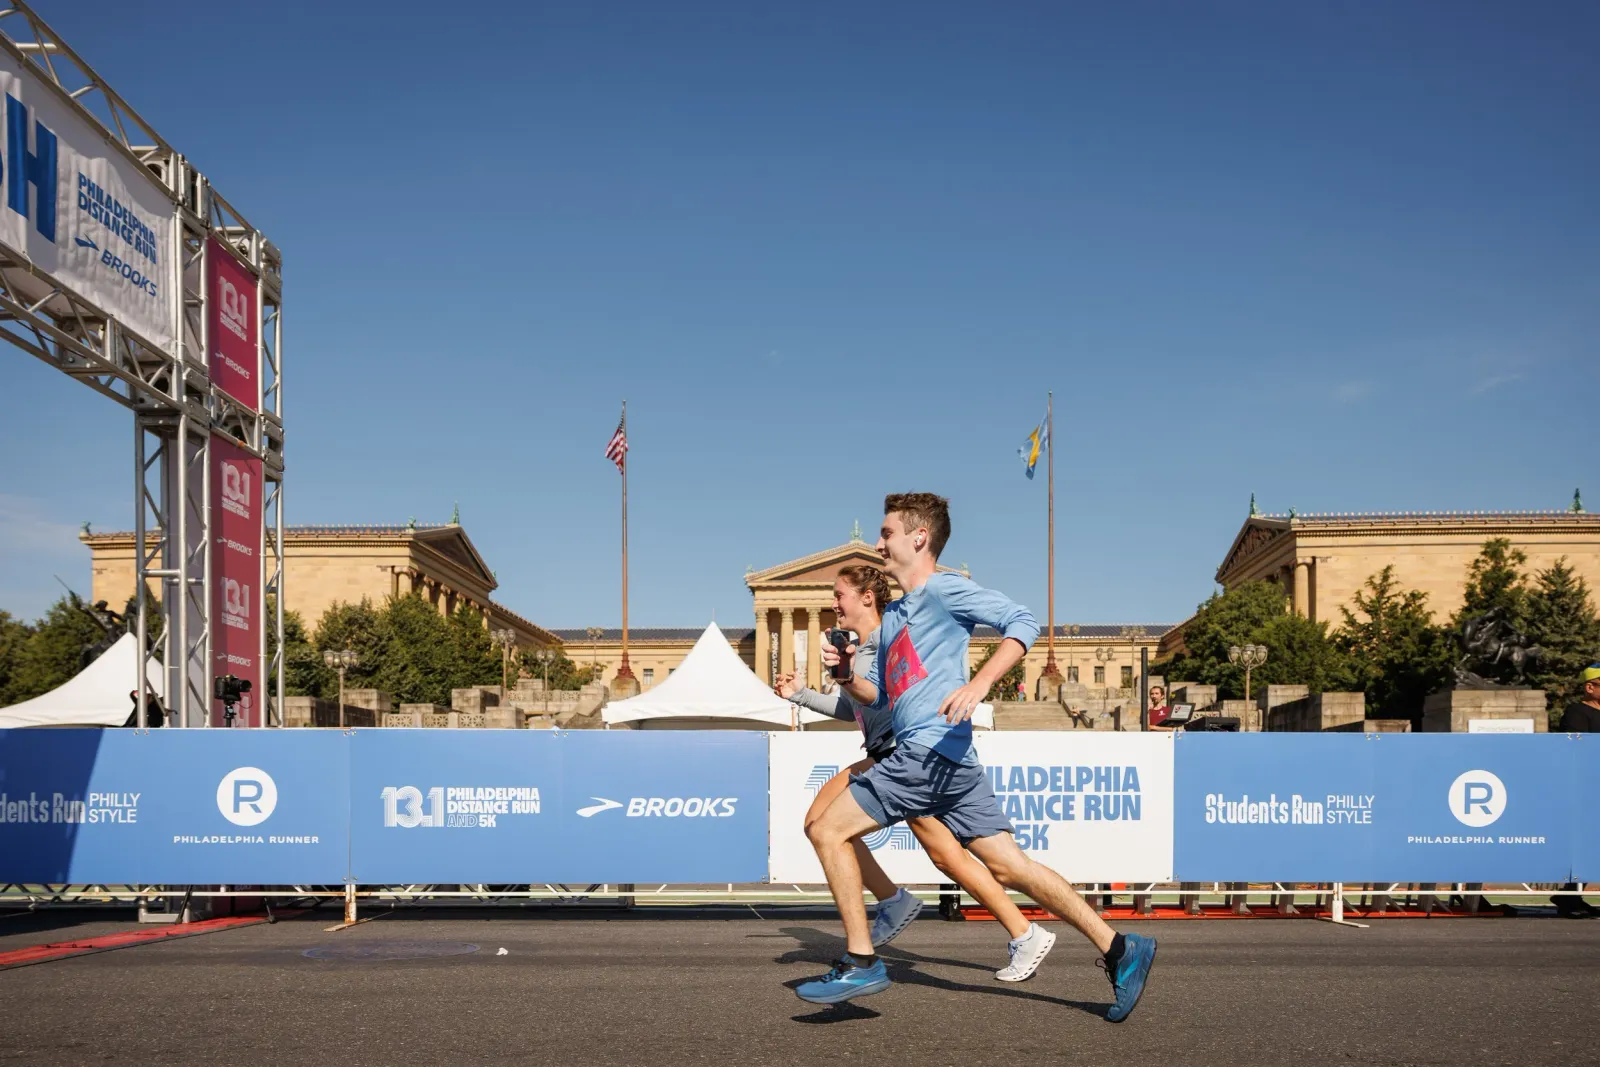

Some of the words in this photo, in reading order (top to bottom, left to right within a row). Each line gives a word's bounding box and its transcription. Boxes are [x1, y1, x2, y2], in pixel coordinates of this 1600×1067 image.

[0, 92, 57, 244] H
[78, 172, 156, 248] PHILADELPHIA
[78, 190, 133, 246] DISTANCE
[135, 235, 157, 264] RUN
[101, 249, 157, 297] BROOKS
[225, 357, 250, 379] BROOKS
[227, 540, 252, 555] BROOKS
[227, 654, 251, 667] BROOKS
[985, 766, 1141, 792] ILADELPHIA
[89, 793, 141, 807] PHILLY
[233, 780, 263, 813] R
[447, 787, 540, 801] PHILADELPHIA
[1326, 795, 1375, 809] PHILLY
[1464, 782, 1493, 815] R
[52, 792, 86, 824] Run
[88, 809, 137, 823] STYLE
[380, 786, 444, 828] 13.1
[447, 801, 508, 813] DISTANCE
[512, 801, 540, 814] RUN
[626, 797, 738, 817] BROOKS
[1084, 795, 1141, 821] RUN
[1205, 793, 1289, 824] Students
[1292, 794, 1323, 824] Run
[1326, 810, 1373, 824] STYLE
[447, 814, 478, 828] AND
[479, 814, 496, 828] 5K
[173, 835, 264, 844] PHILADELPHIA
[269, 835, 320, 844] RUNNER
[1014, 824, 1049, 851] 5K
[1407, 836, 1494, 844] PHILADELPHIA
[1498, 836, 1546, 844] RUNNER
